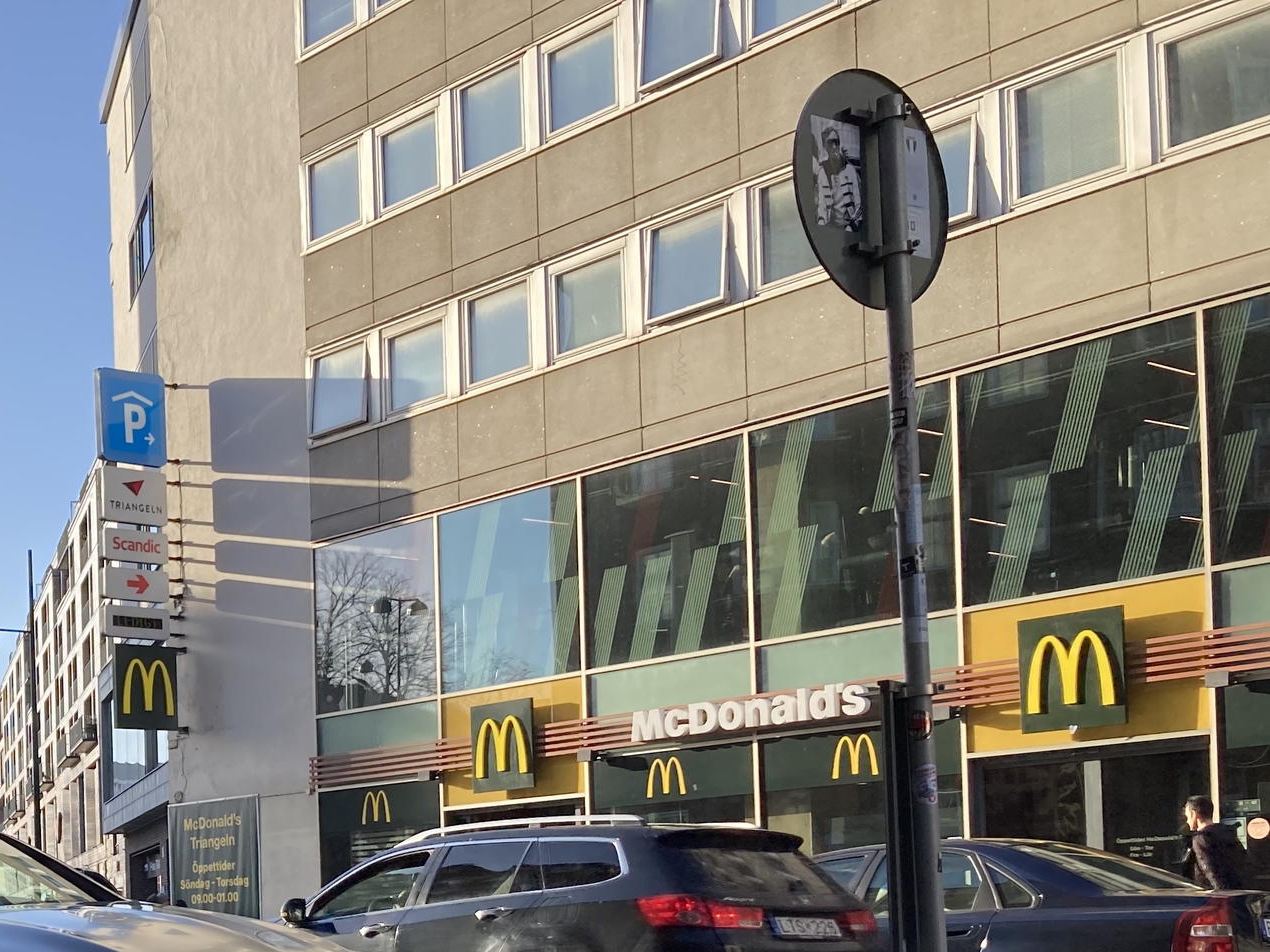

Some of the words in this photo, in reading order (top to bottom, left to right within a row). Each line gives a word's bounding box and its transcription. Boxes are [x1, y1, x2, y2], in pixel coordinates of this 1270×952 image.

[124, 402, 147, 444] P
[110, 500, 162, 514] TRIANGELN
[112, 536, 161, 554] Scandic
[631, 683, 872, 742] McDonald's
[184, 813, 241, 831] McDonald's
[190, 834, 235, 850] Triangeln
[192, 861, 236, 874] Öppettider
[180, 879, 210, 890] Söndag
[216, 876, 249, 888] Torsdag
[191, 892, 239, 904] 09.00-01.00
